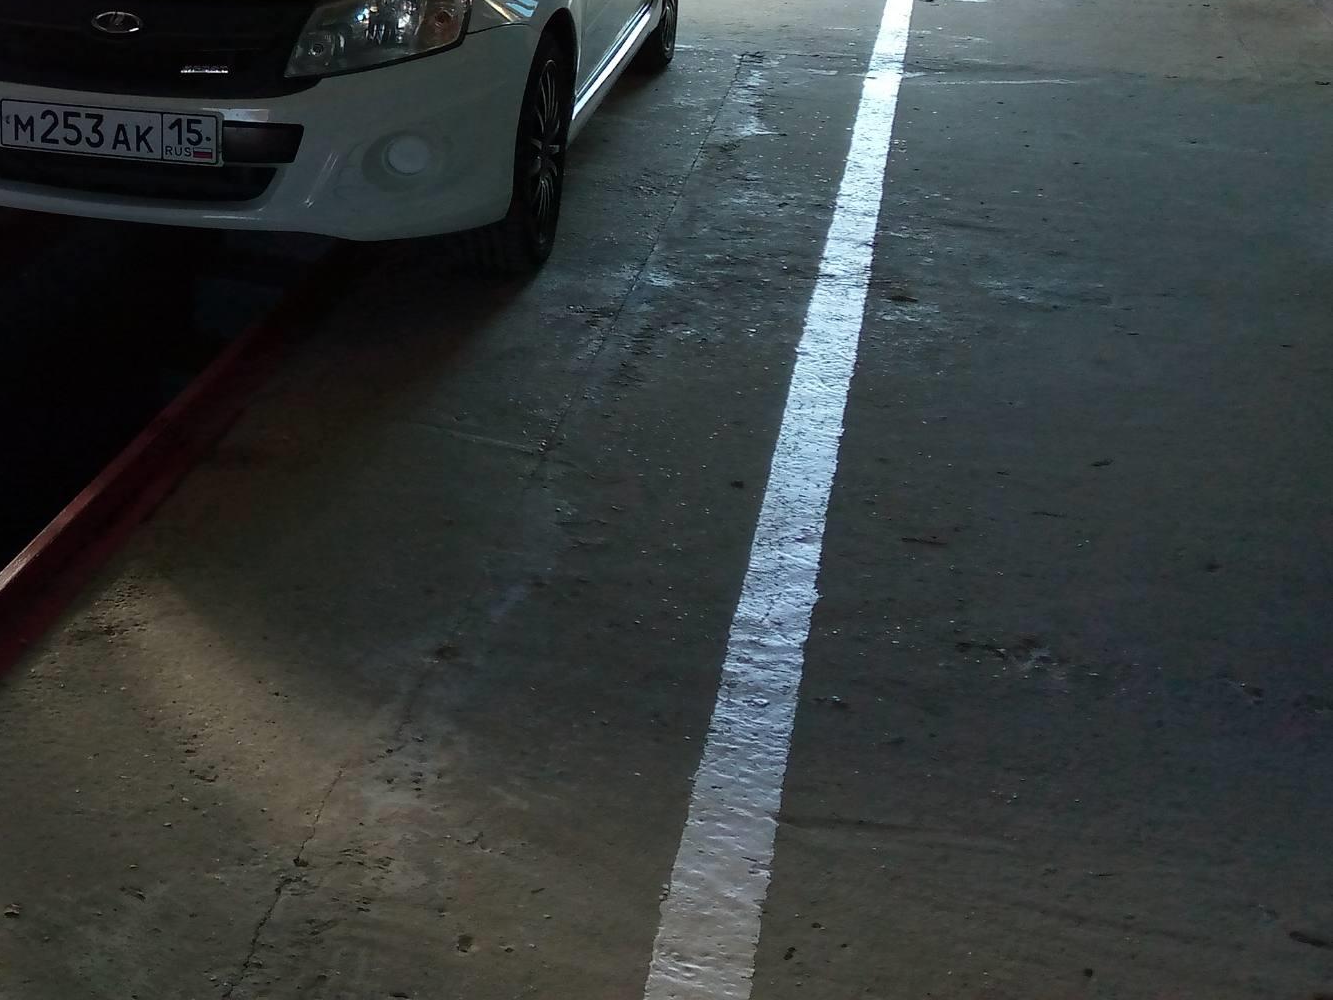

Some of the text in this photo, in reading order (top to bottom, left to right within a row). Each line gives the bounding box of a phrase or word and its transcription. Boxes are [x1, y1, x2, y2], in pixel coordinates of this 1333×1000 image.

[13, 109, 204, 154] М253АК 15
[164, 144, 192, 158] RUS
